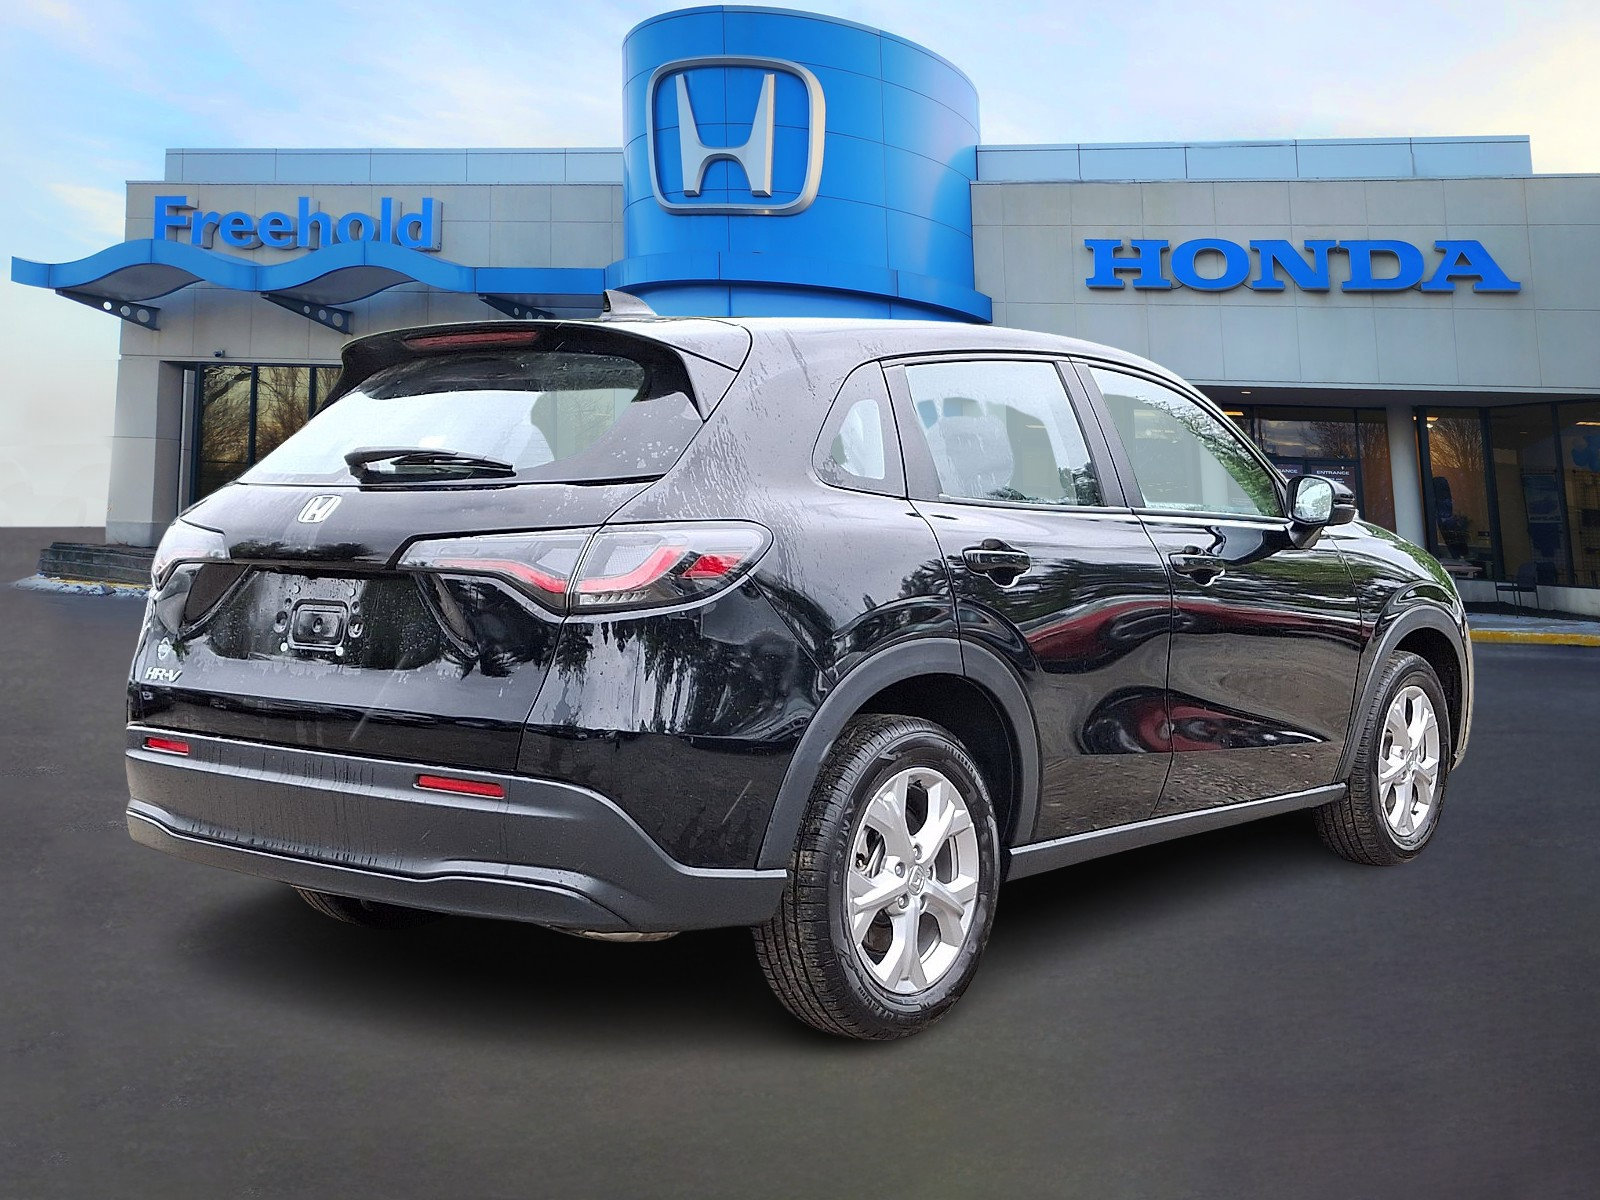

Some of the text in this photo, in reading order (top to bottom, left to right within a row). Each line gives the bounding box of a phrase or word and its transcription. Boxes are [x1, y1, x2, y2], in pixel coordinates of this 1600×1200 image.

[153, 194, 441, 251] Freehold
[1083, 237, 1522, 294] HONDA
[144, 666, 183, 683] HR-V
